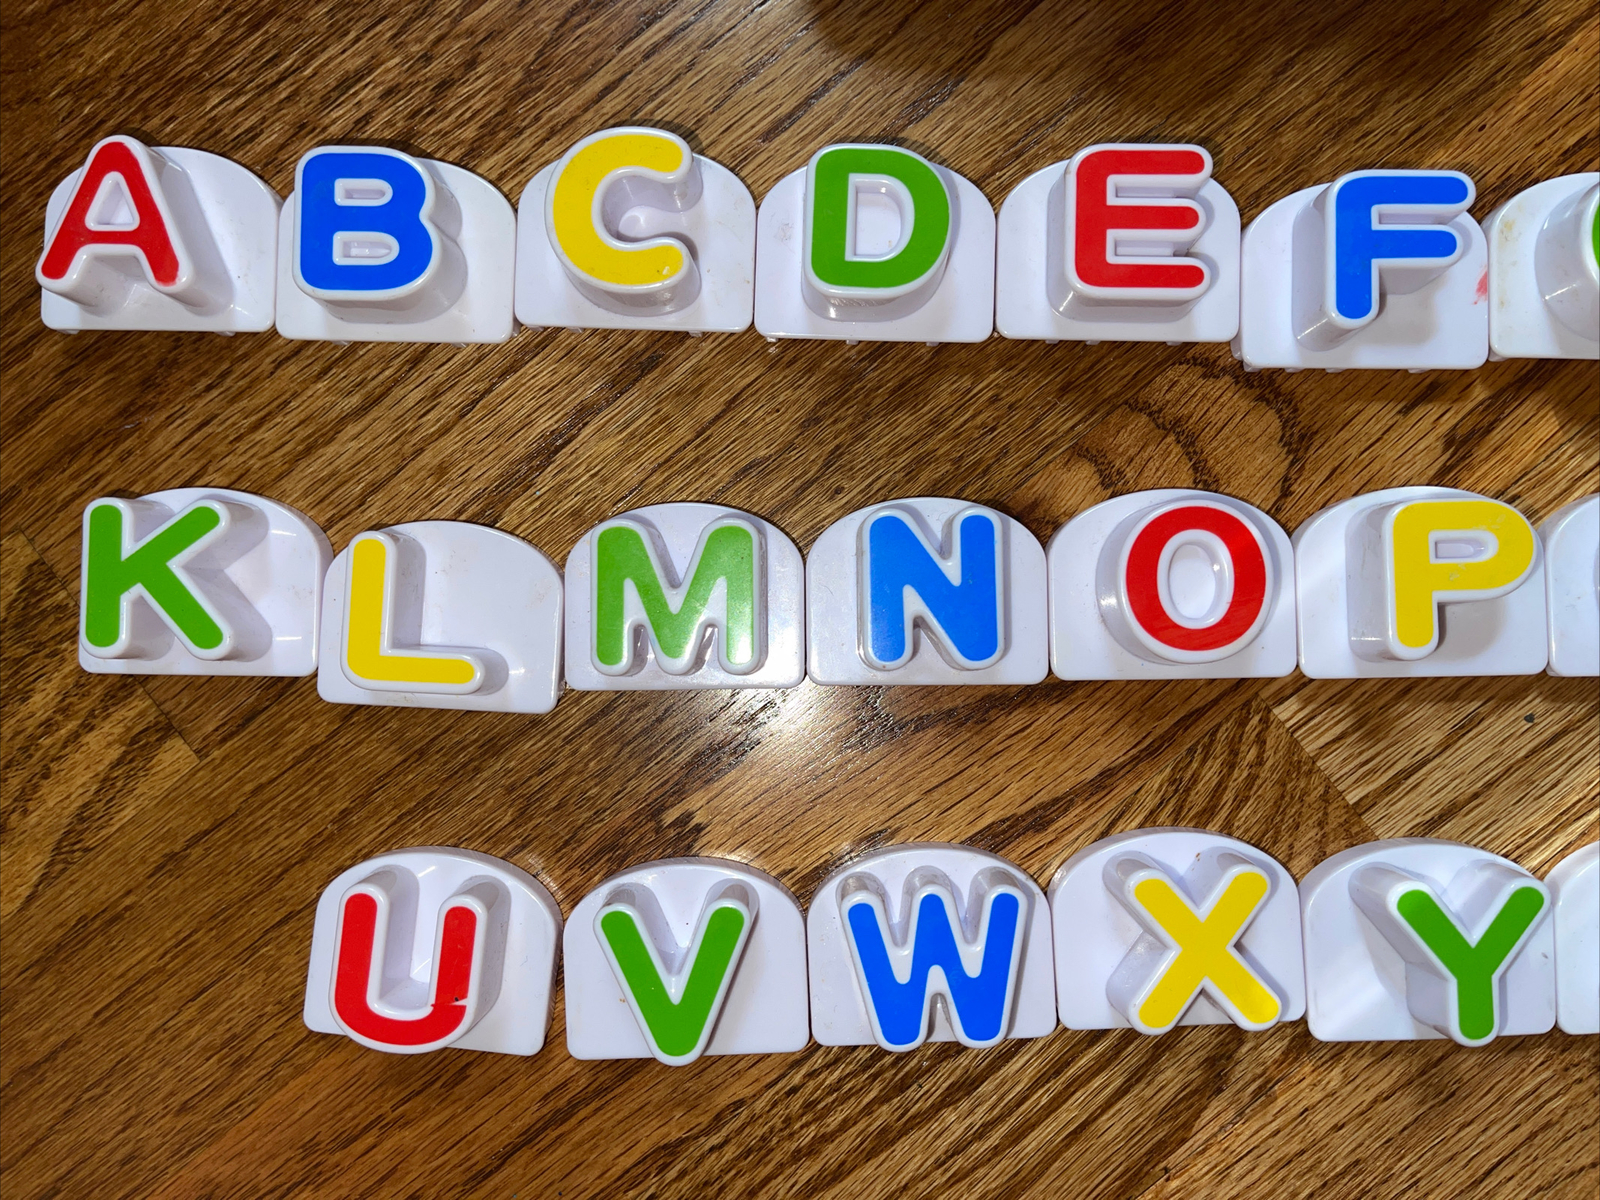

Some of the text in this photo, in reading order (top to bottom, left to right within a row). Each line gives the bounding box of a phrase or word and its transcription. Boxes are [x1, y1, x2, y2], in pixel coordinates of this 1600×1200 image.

[40, 139, 183, 287] A
[299, 151, 434, 292] B
[552, 132, 691, 286] C
[810, 147, 951, 289] D
[1073, 149, 1211, 290] E
[1334, 173, 1471, 321] F
[82, 500, 1535, 685] K L M N O P
[333, 870, 1546, 1058] U V W X Y
